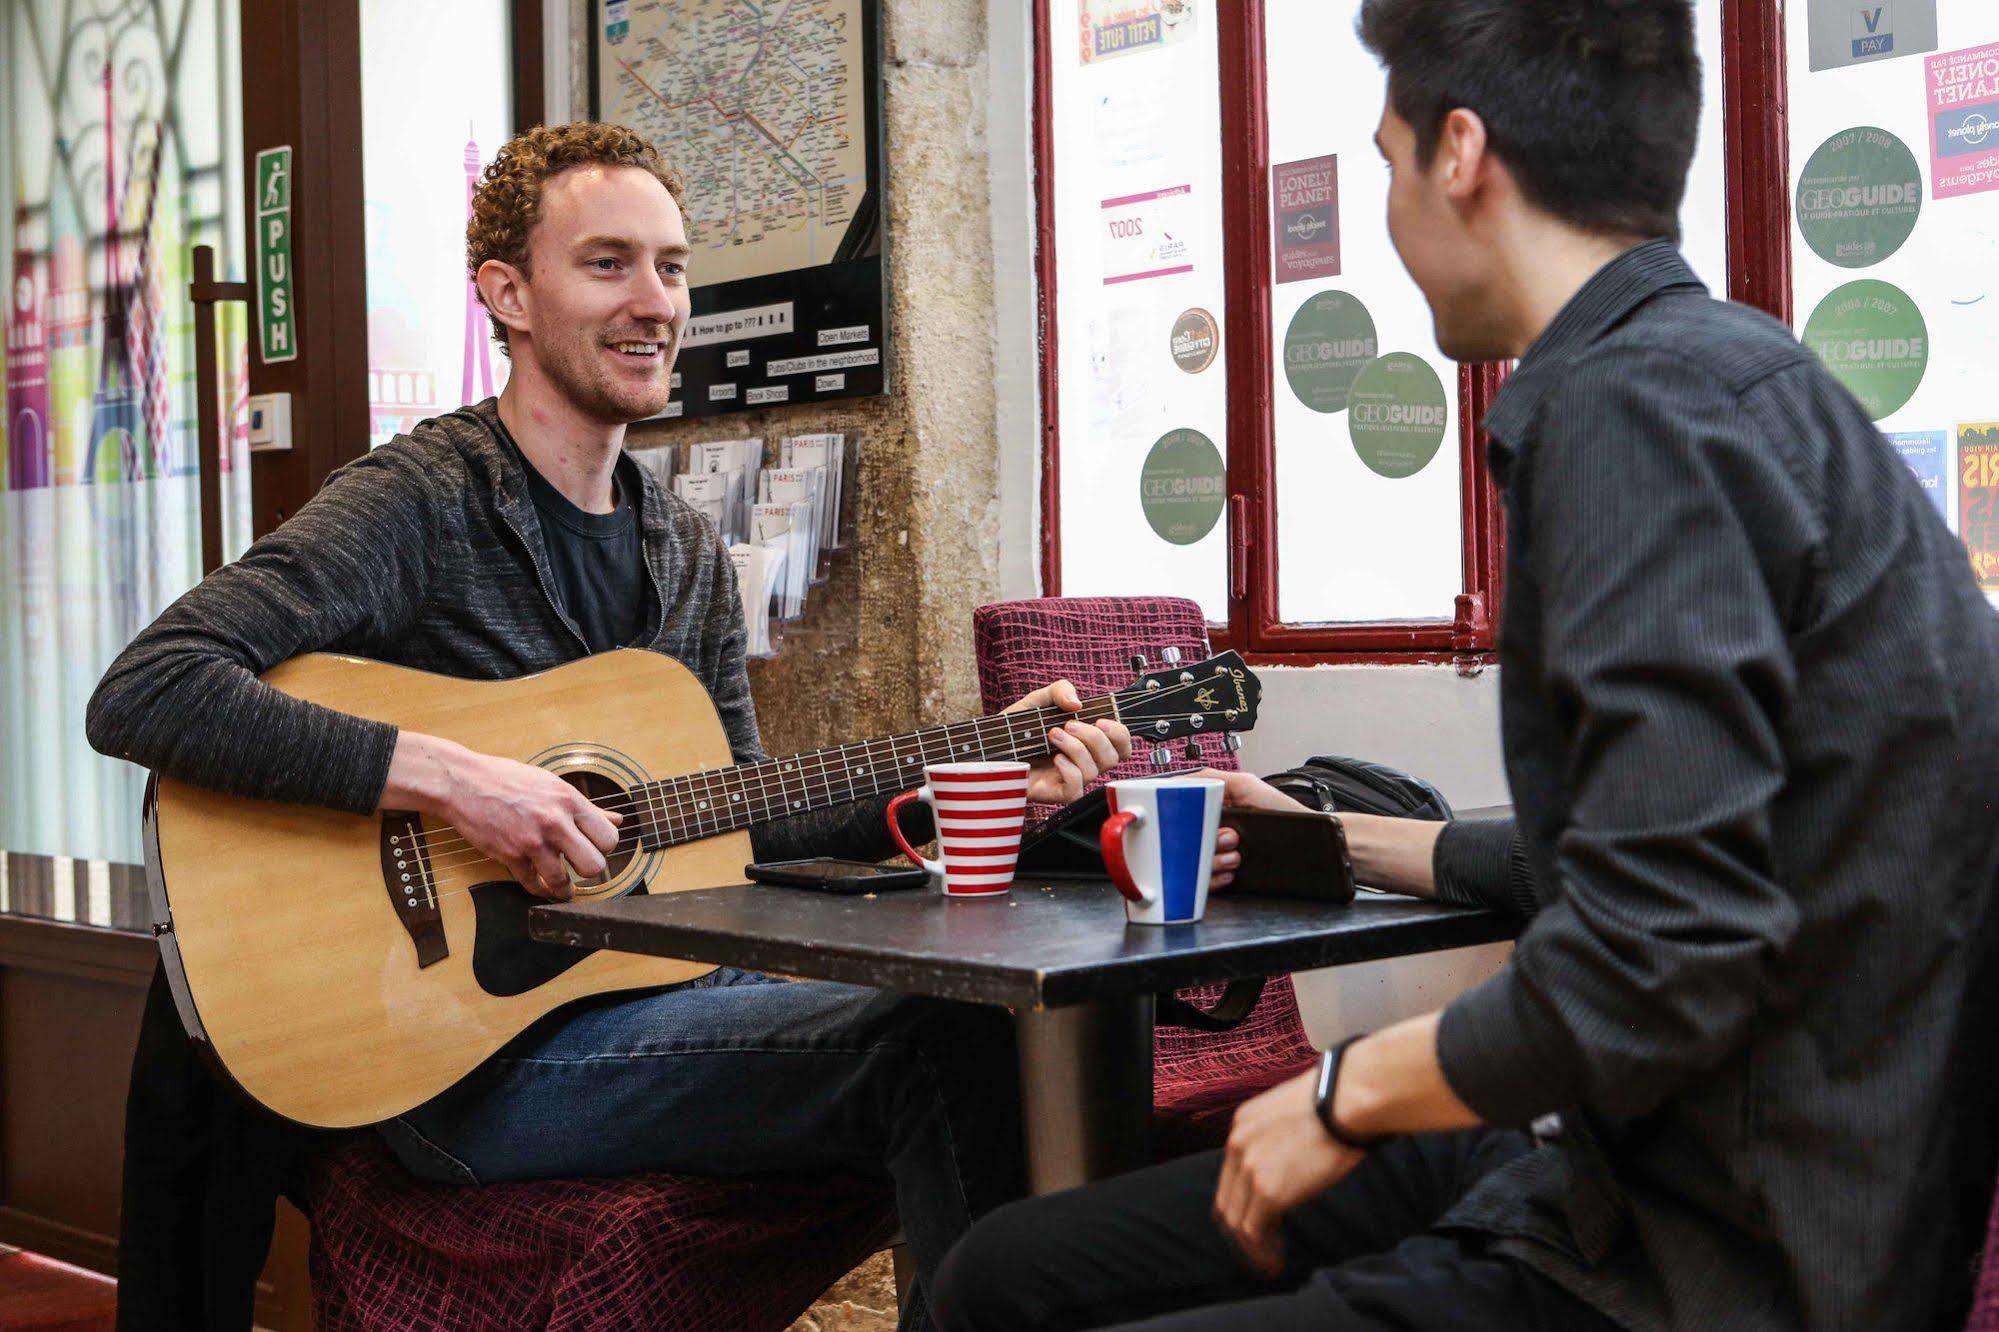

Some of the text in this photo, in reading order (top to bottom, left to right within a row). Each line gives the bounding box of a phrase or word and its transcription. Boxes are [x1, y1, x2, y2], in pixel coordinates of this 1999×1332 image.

[1861, 38, 1884, 53] PAY
[1831, 131, 1857, 152] 2007
[1866, 131, 1893, 149] 2008
[1279, 171, 1332, 193] LONELY
[1280, 186, 1333, 208] PLANET
[1800, 182, 1920, 210] GEOGUIDE
[268, 219, 288, 351] PUSH
[699, 326, 715, 335] How
[716, 324, 724, 333] to
[725, 323, 734, 334] go
[734, 321, 743, 330] to
[819, 328, 868, 344] Open Markets
[816, 358, 827, 368] the
[828, 352, 877, 367] neighborhood
[1287, 337, 1376, 363] GEOGUIDE
[747, 389, 788, 401] Book Shops
[1354, 403, 1445, 425] GEOGUIDE
[793, 439, 816, 448] PARIS
[773, 474, 795, 482] PARIS
[1143, 475, 1226, 497] GEOGUIDE
[764, 507, 786, 517] PARIS
[1228, 666, 1249, 713] Ibanez
